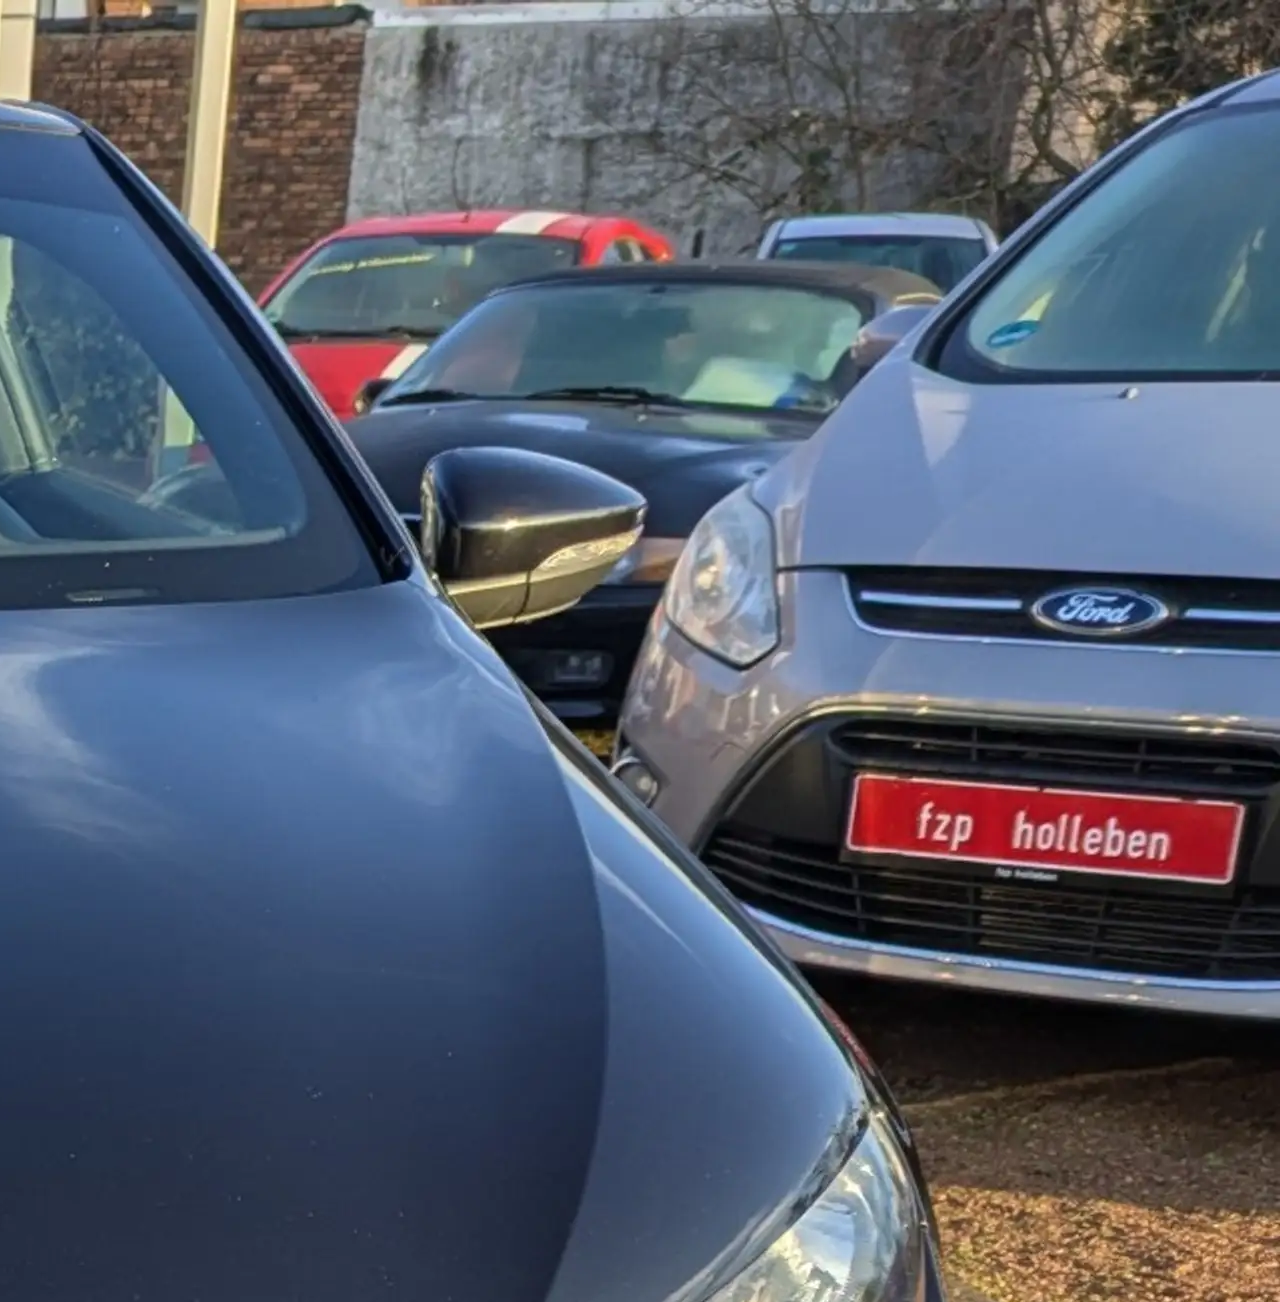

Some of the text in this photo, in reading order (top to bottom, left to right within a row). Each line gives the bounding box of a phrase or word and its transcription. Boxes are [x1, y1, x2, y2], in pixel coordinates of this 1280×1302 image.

[1057, 594, 1136, 623] Ford
[917, 801, 1170, 861] fzp holleben
